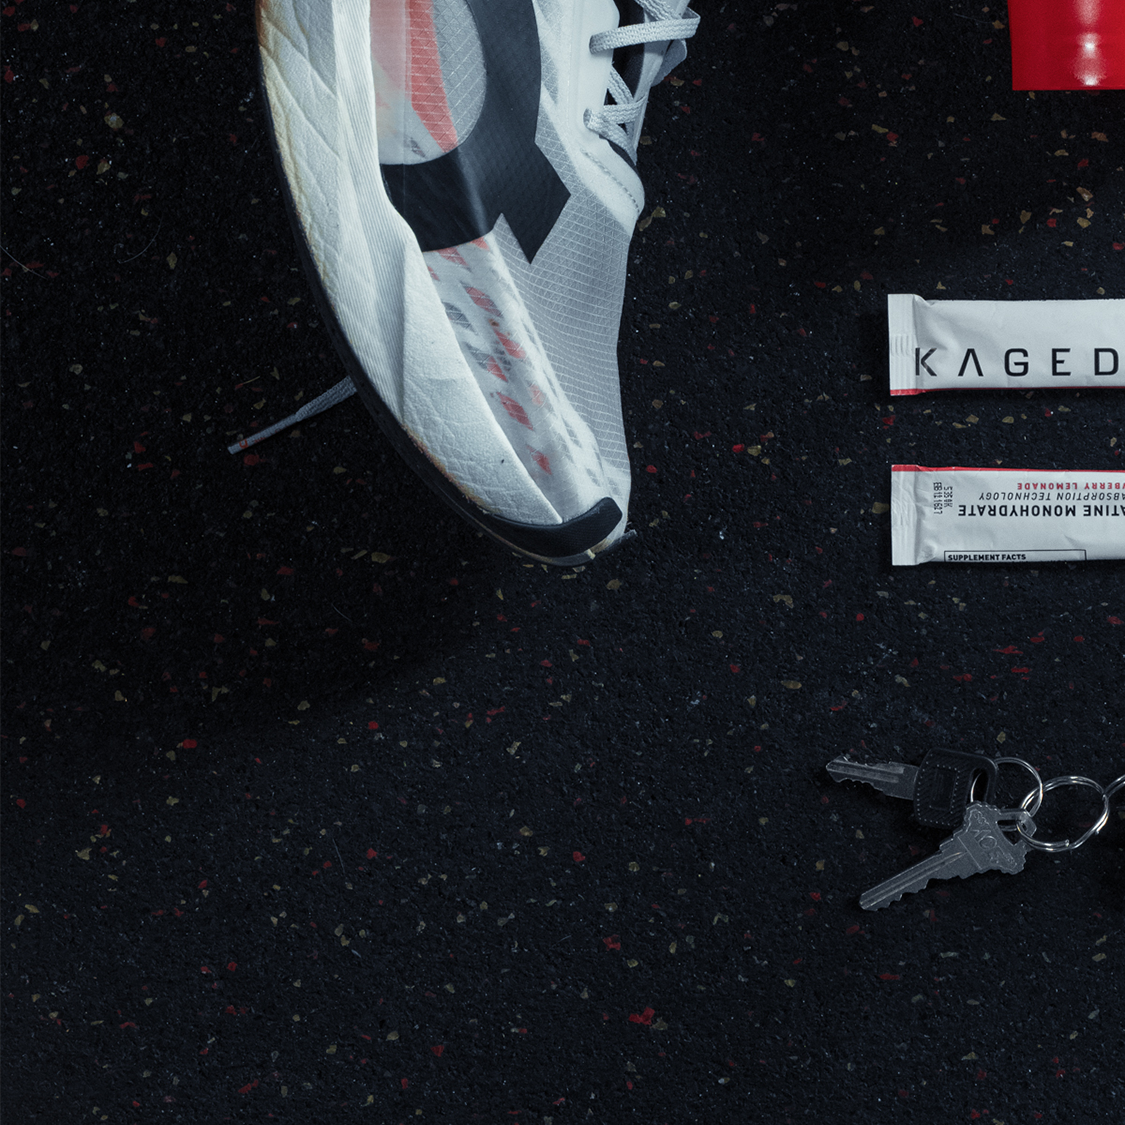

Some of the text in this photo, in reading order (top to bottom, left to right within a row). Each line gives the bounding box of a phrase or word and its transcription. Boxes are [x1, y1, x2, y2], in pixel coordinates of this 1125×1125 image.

[1016, 482, 1077, 490] LEMONADE
[979, 492, 1051, 501] TECHNOLOGY
[958, 505, 1076, 516] MONOHYDRATE
[1002, 553, 1026, 561] FACTS
